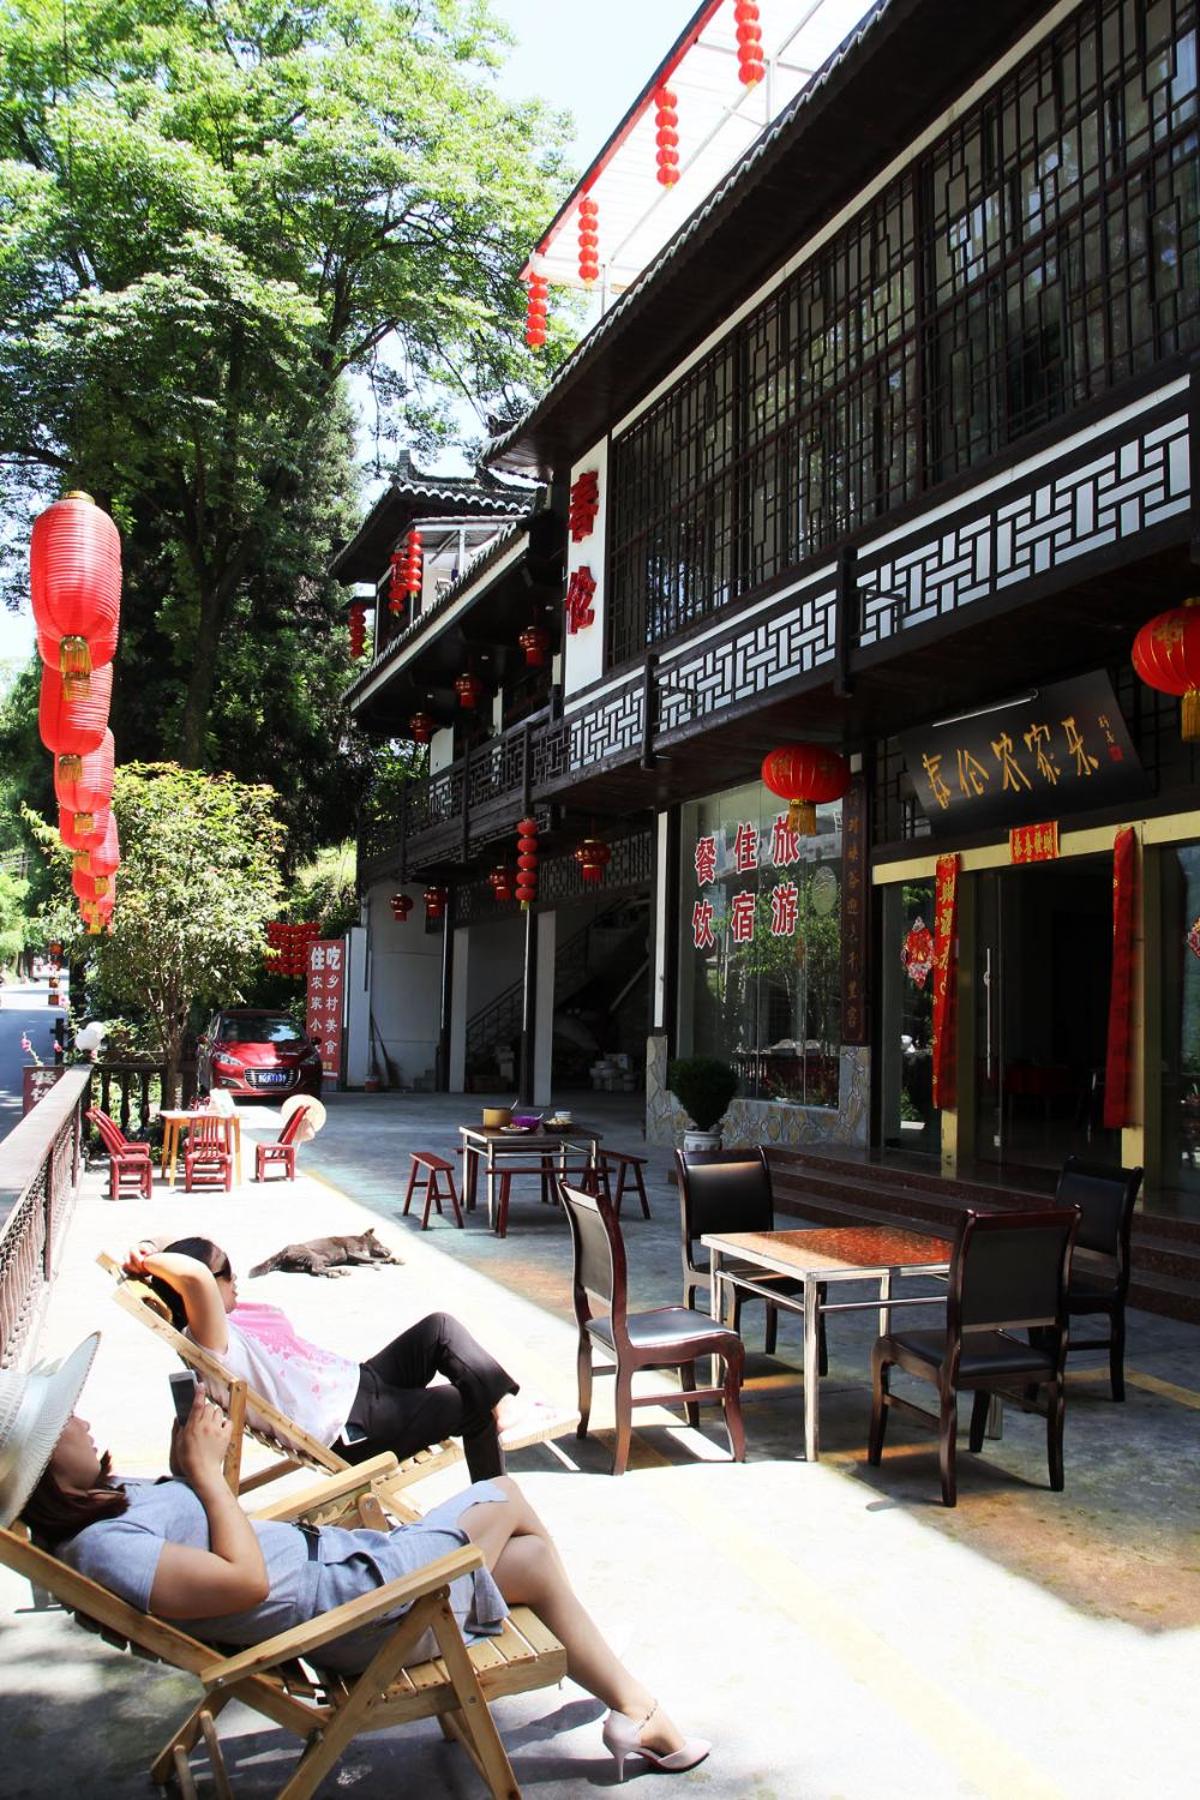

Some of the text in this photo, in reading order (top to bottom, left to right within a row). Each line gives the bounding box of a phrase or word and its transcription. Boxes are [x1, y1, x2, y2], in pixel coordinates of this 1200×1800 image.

[692, 836, 716, 949] 餐饮
[731, 821, 758, 942] 住宿
[771, 813, 800, 936] 旅游
